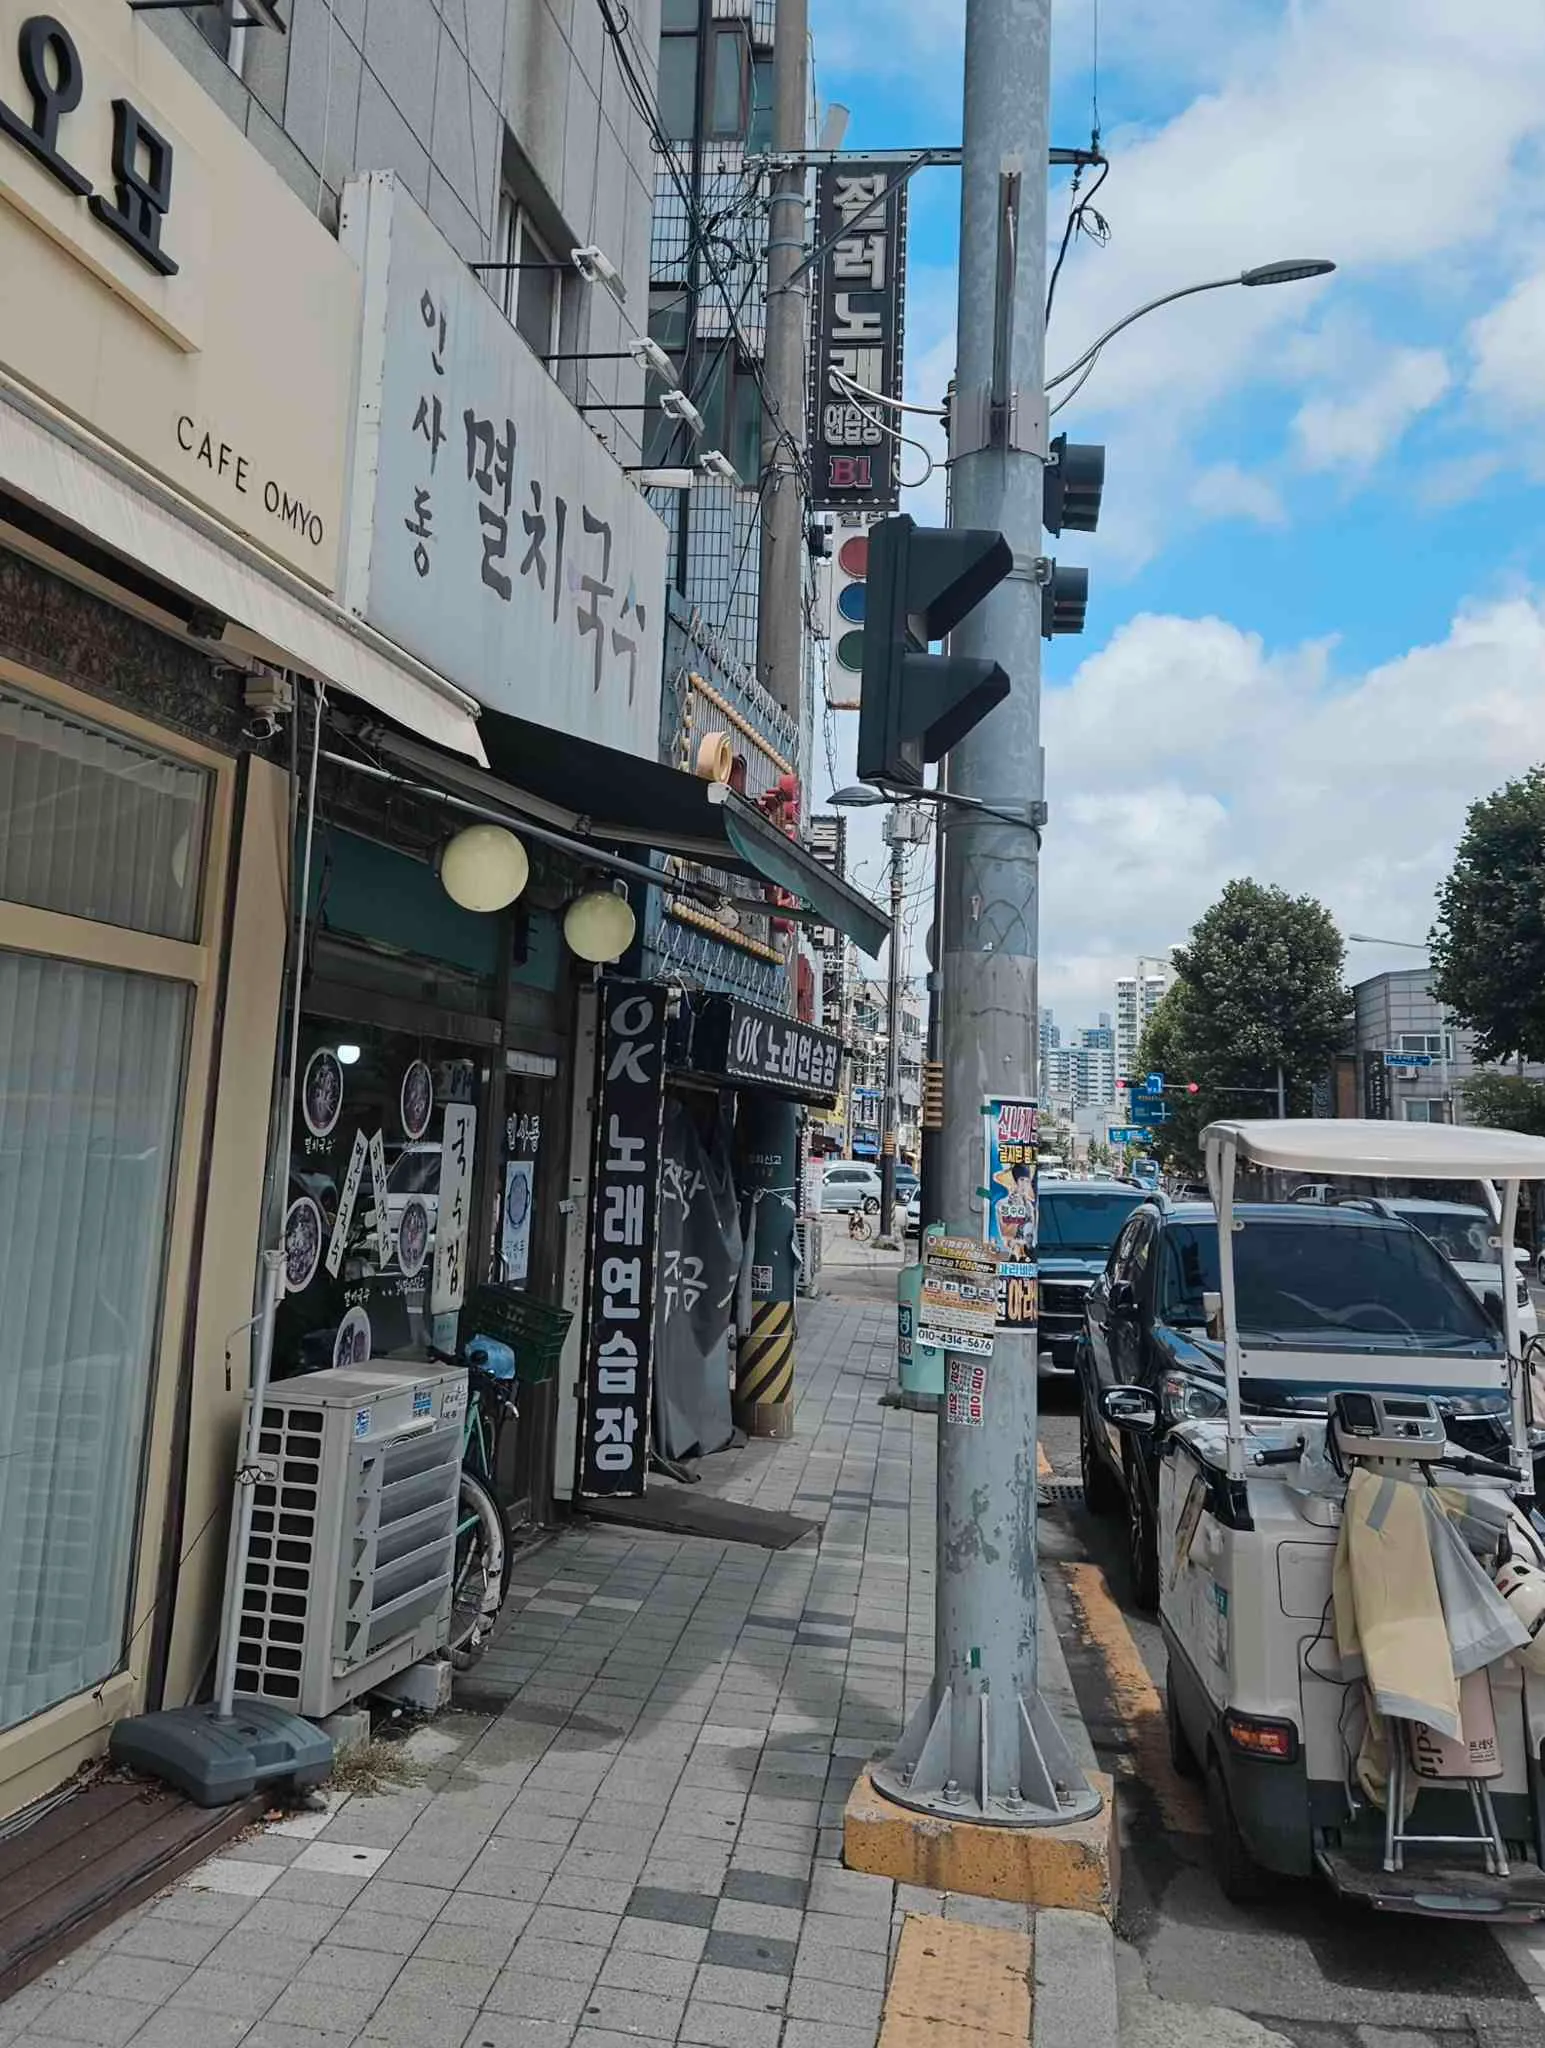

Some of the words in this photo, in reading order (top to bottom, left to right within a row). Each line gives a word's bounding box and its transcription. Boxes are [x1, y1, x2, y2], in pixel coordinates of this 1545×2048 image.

[0, 15, 179, 276] 오묘
[176, 415, 249, 494] CAFE
[823, 403, 884, 447] 연습장
[463, 407, 647, 707] 멸치국수
[606, 995, 654, 1084] OK
[736, 1016, 763, 1064] OK
[766, 1023, 838, 1088] 노래연습장
[594, 1113, 646, 1472] 노래연습장
[918, 1329, 992, 1351] 010-4314-5676
